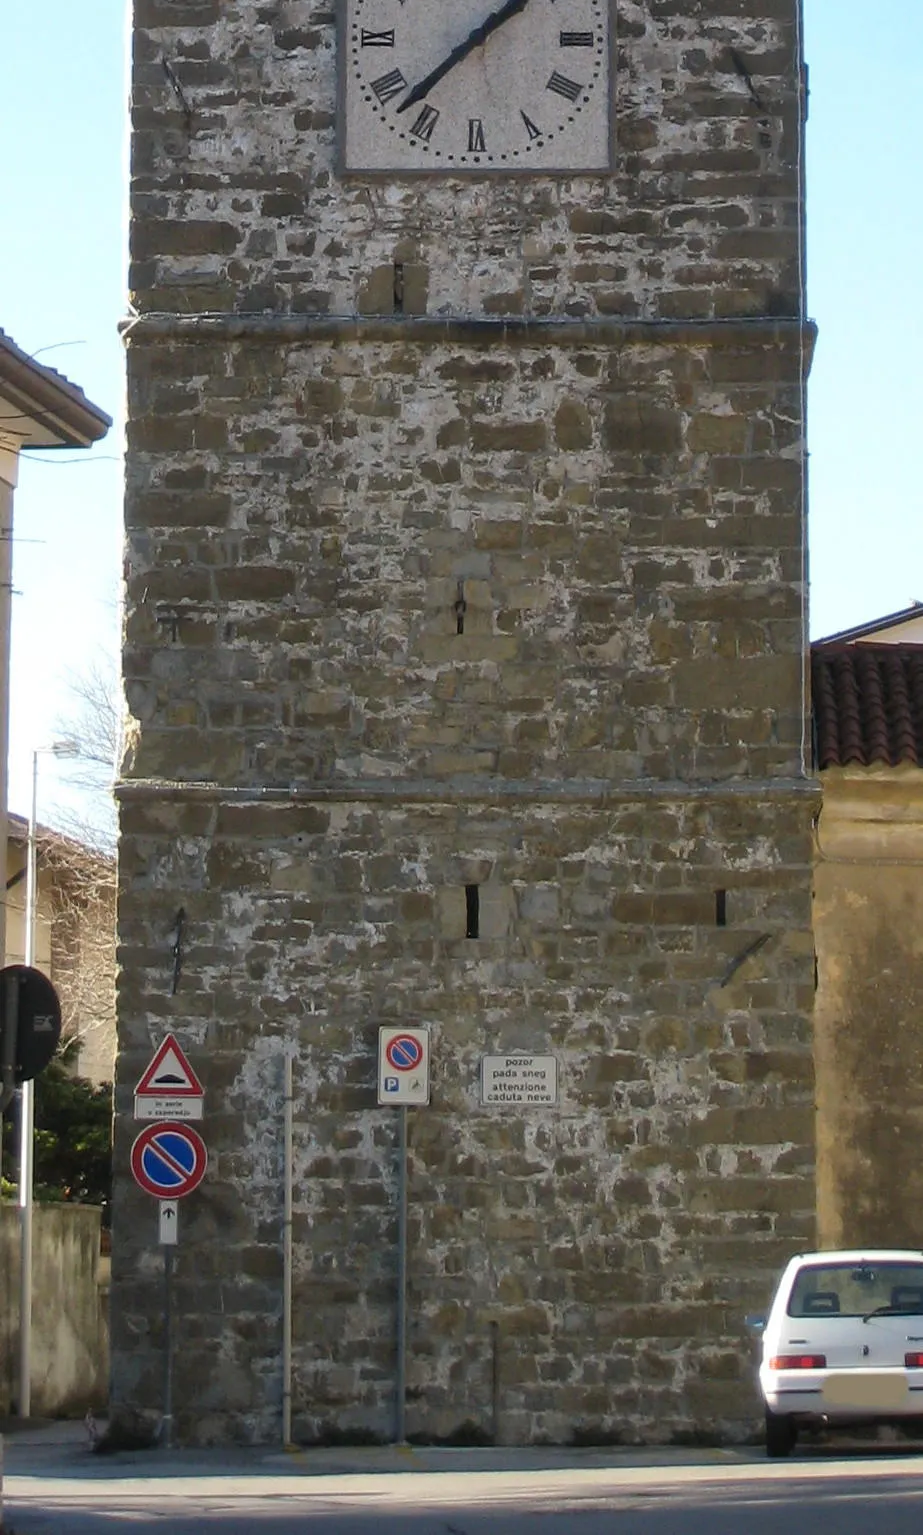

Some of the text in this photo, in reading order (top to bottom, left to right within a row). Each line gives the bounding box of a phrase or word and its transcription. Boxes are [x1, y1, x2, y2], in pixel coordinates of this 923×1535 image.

[560, 31, 593, 47] III
[520, 109, 542, 140] V
[506, 1059, 533, 1067] pozor
[492, 1069, 546, 1079] pada sneg
[386, 1079, 396, 1090] P
[492, 1083, 547, 1092] attenzione
[487, 1093, 522, 1101] caduta
